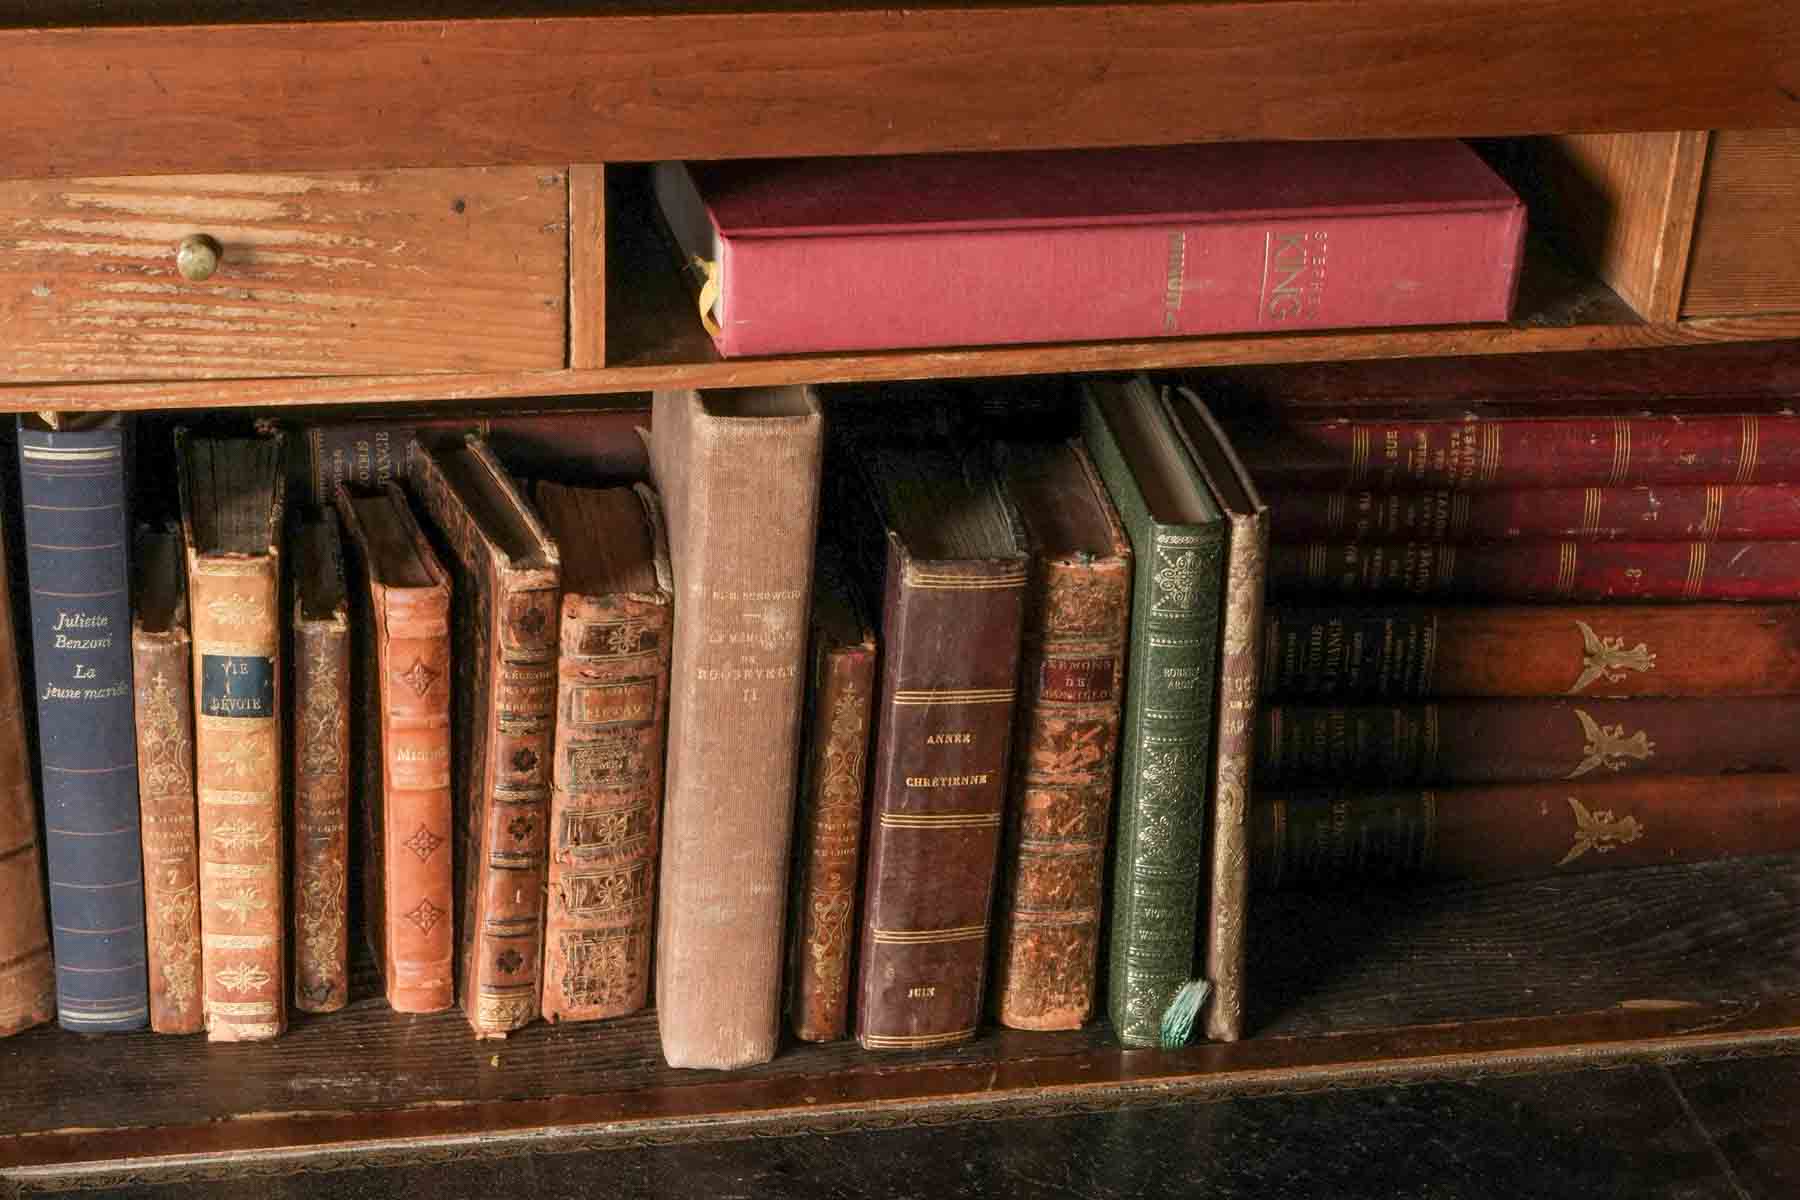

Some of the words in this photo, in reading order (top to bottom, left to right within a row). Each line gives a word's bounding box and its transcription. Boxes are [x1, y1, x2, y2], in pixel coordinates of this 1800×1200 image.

[1268, 231, 1308, 322] KING
[52, 612, 109, 631] Juliette
[56, 632, 113, 649] Benzoni
[73, 664, 96, 679] La
[220, 663, 249, 675] VIE
[41, 682, 81, 700] jeune
[1065, 678, 1087, 688] DE
[907, 987, 936, 999] JUIN
